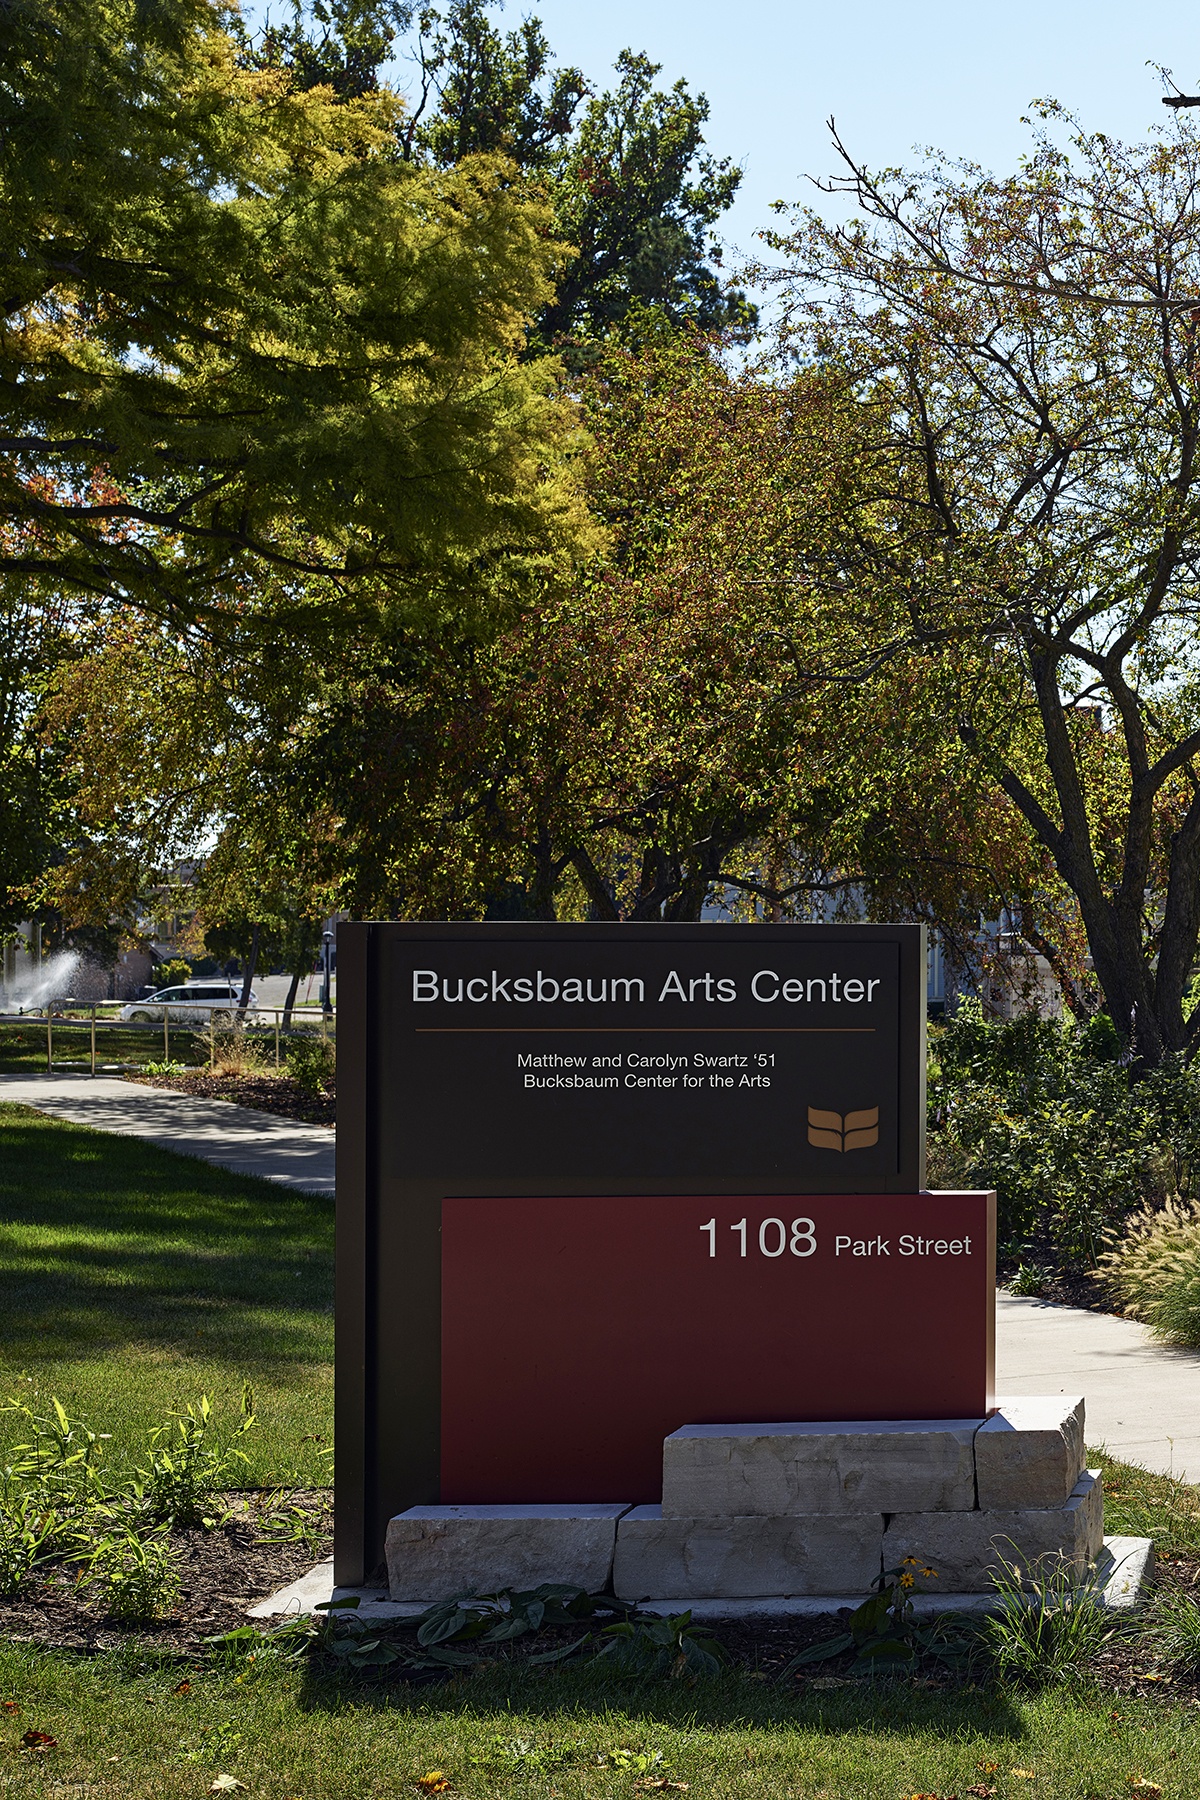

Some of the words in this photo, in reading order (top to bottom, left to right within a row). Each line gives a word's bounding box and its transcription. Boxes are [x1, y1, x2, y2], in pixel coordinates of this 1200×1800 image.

[412, 970, 645, 1003] Bucksbaum
[658, 970, 737, 1003] Arts
[750, 970, 881, 1003] Center
[517, 1053, 588, 1068] Matthew
[591, 1053, 622, 1068] and
[626, 1053, 688, 1071] Carolyn
[693, 1053, 749, 1068] Swartz
[524, 1073, 619, 1088] Bucksbaum
[624, 1073, 679, 1088] Center
[682, 1073, 705, 1088] for
[708, 1073, 735, 1088] the
[738, 1073, 771, 1088] Arts
[699, 1217, 817, 1258] 1108
[834, 1235, 891, 1257] Park
[898, 1234, 972, 1257] Street
